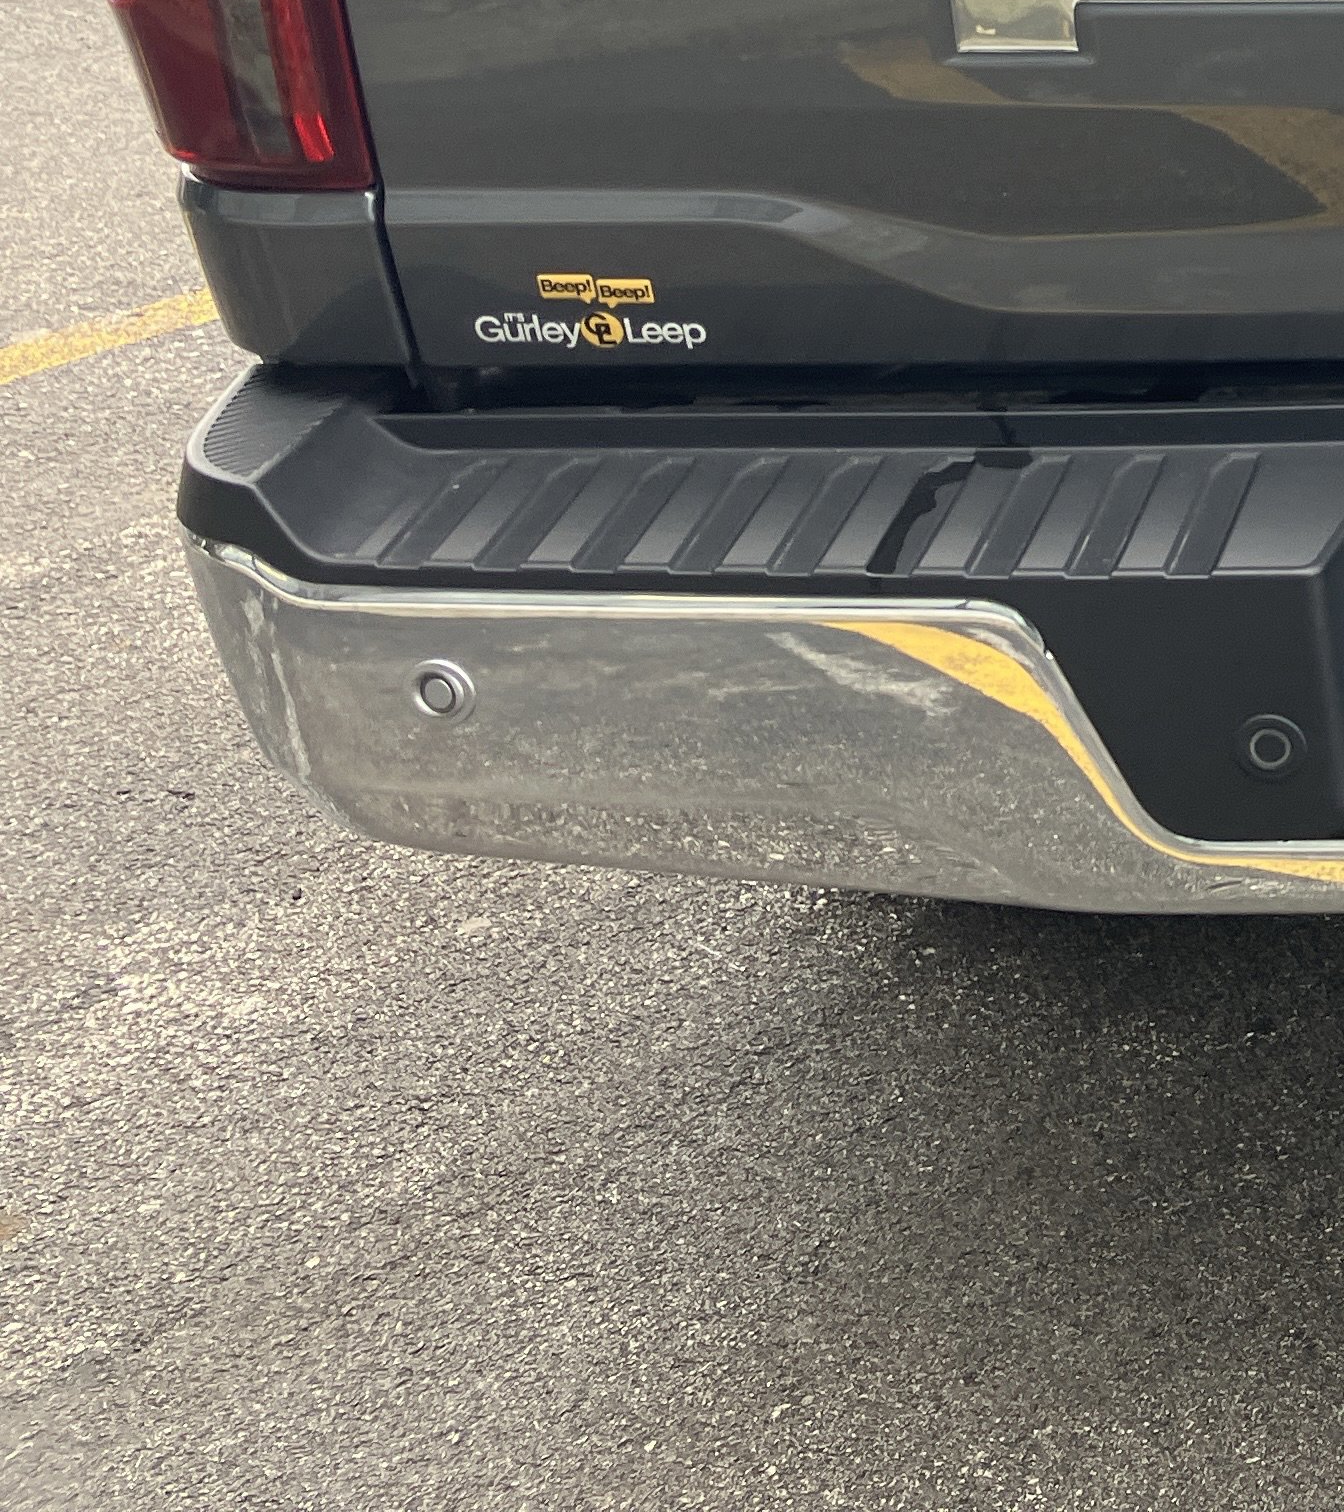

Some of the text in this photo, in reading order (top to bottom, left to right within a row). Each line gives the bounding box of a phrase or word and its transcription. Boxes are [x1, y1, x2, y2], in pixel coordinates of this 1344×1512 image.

[540, 278, 650, 300] Beep! Beep!
[623, 317, 707, 349] Leep
